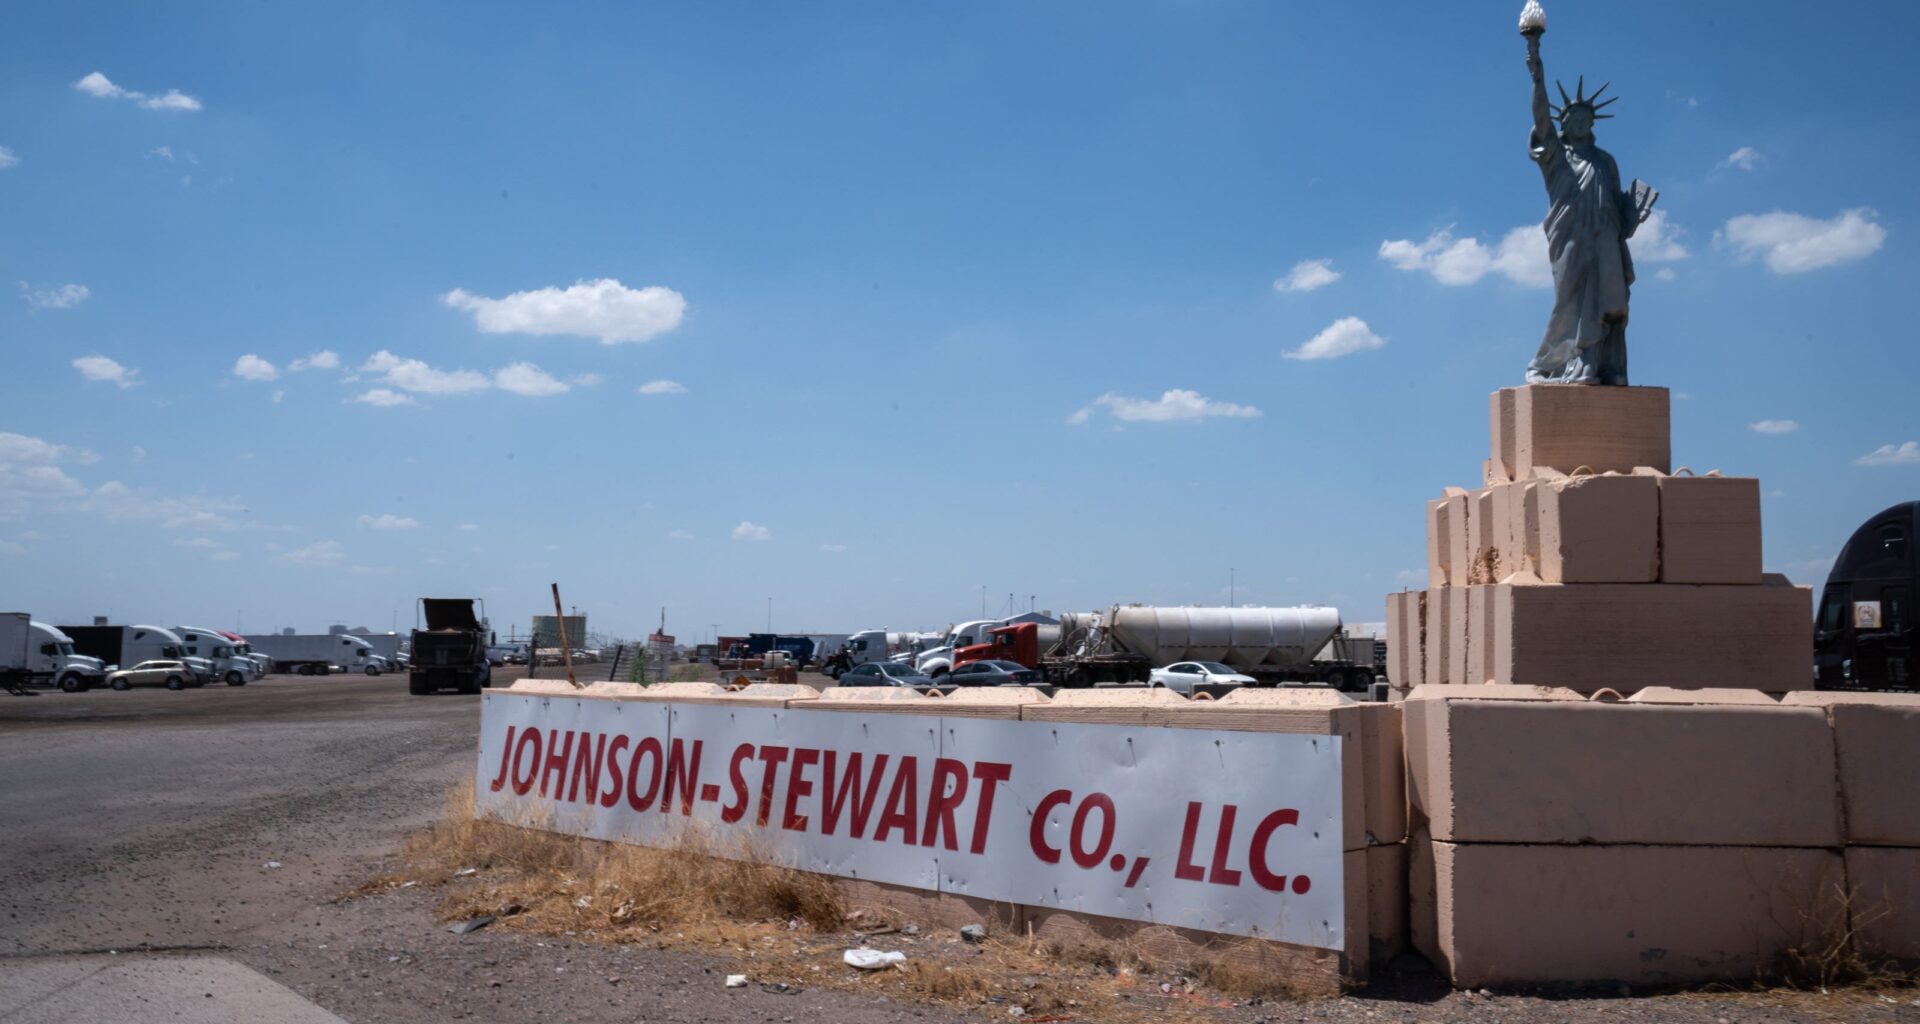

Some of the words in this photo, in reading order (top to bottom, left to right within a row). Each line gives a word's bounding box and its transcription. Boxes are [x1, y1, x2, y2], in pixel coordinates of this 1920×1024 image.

[490, 725, 1012, 855] JOHNSON-STEWART
[1029, 789, 1150, 888] CO.,
[1175, 801, 1311, 895] LLC.
